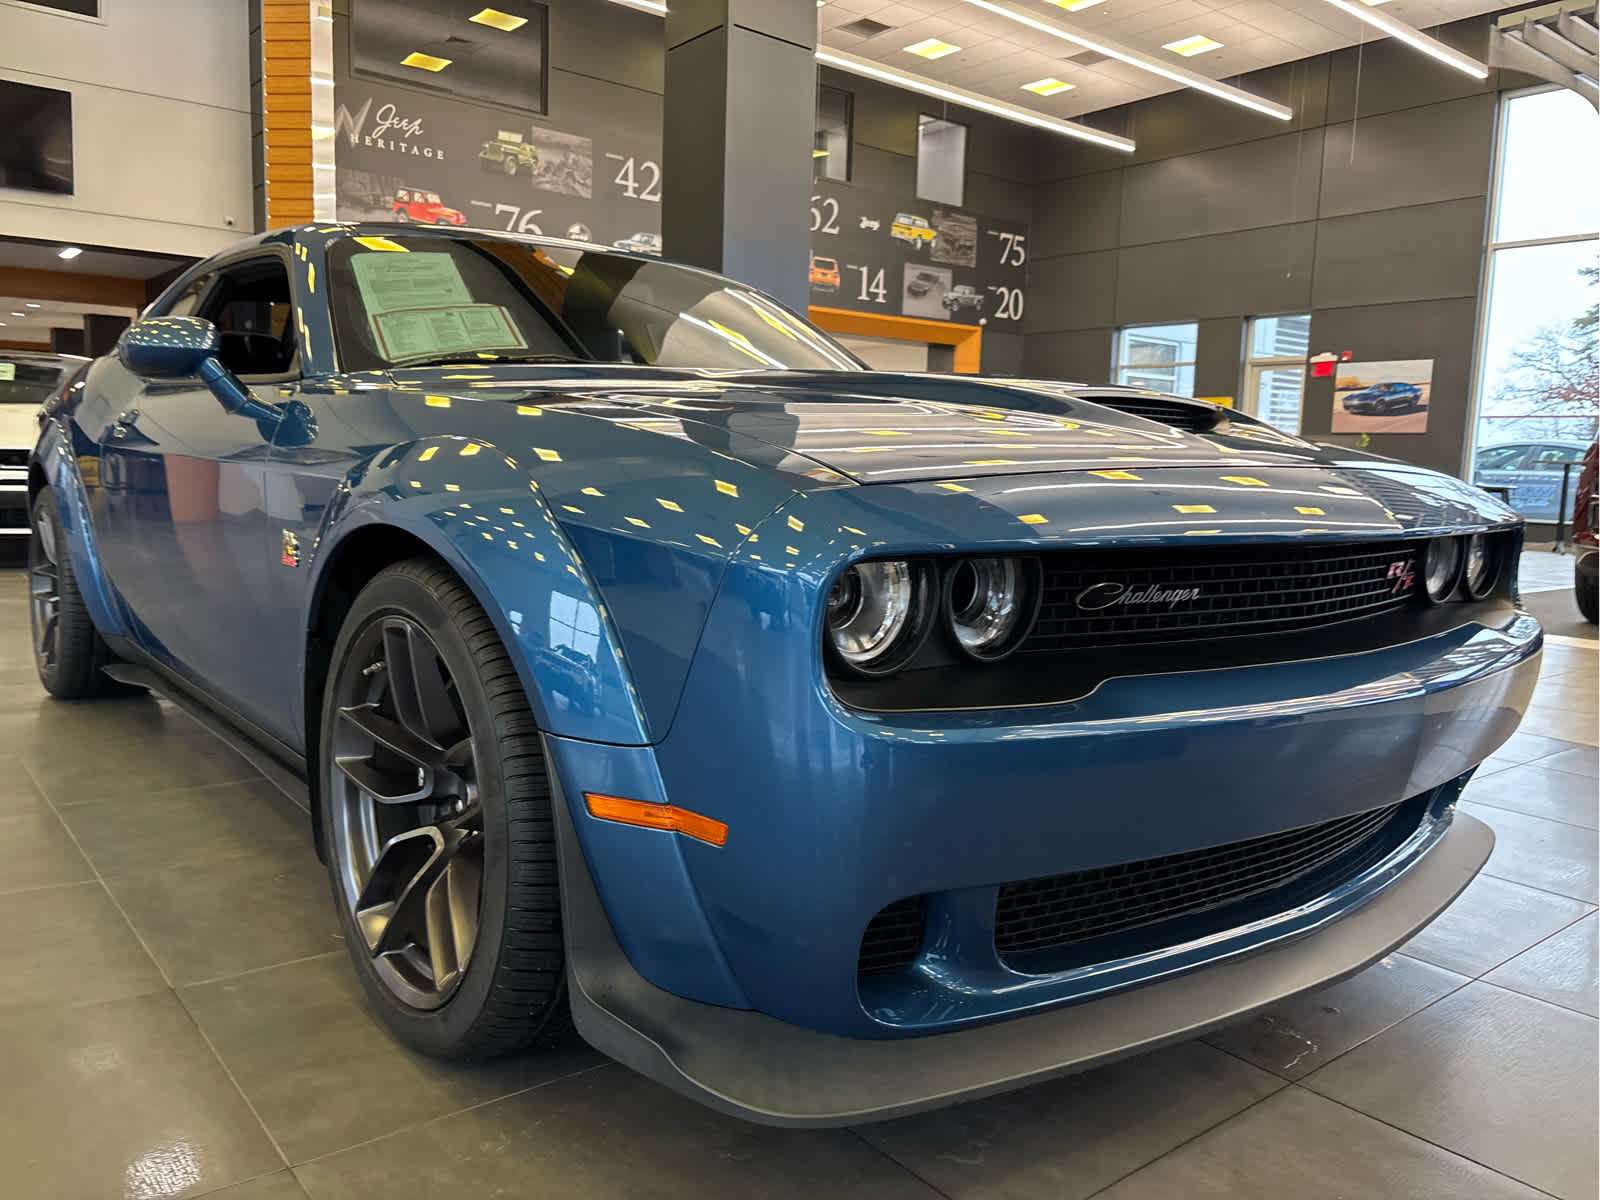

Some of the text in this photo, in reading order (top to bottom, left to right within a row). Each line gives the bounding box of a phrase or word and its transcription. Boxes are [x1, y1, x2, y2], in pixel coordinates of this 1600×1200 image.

[371, 103, 424, 139] Jeep
[350, 133, 445, 160] HERITAGE
[999, 232, 1026, 267] 75
[857, 265, 887, 303] 14
[994, 286, 1024, 321] 20
[1076, 582, 1200, 610] Challenger
